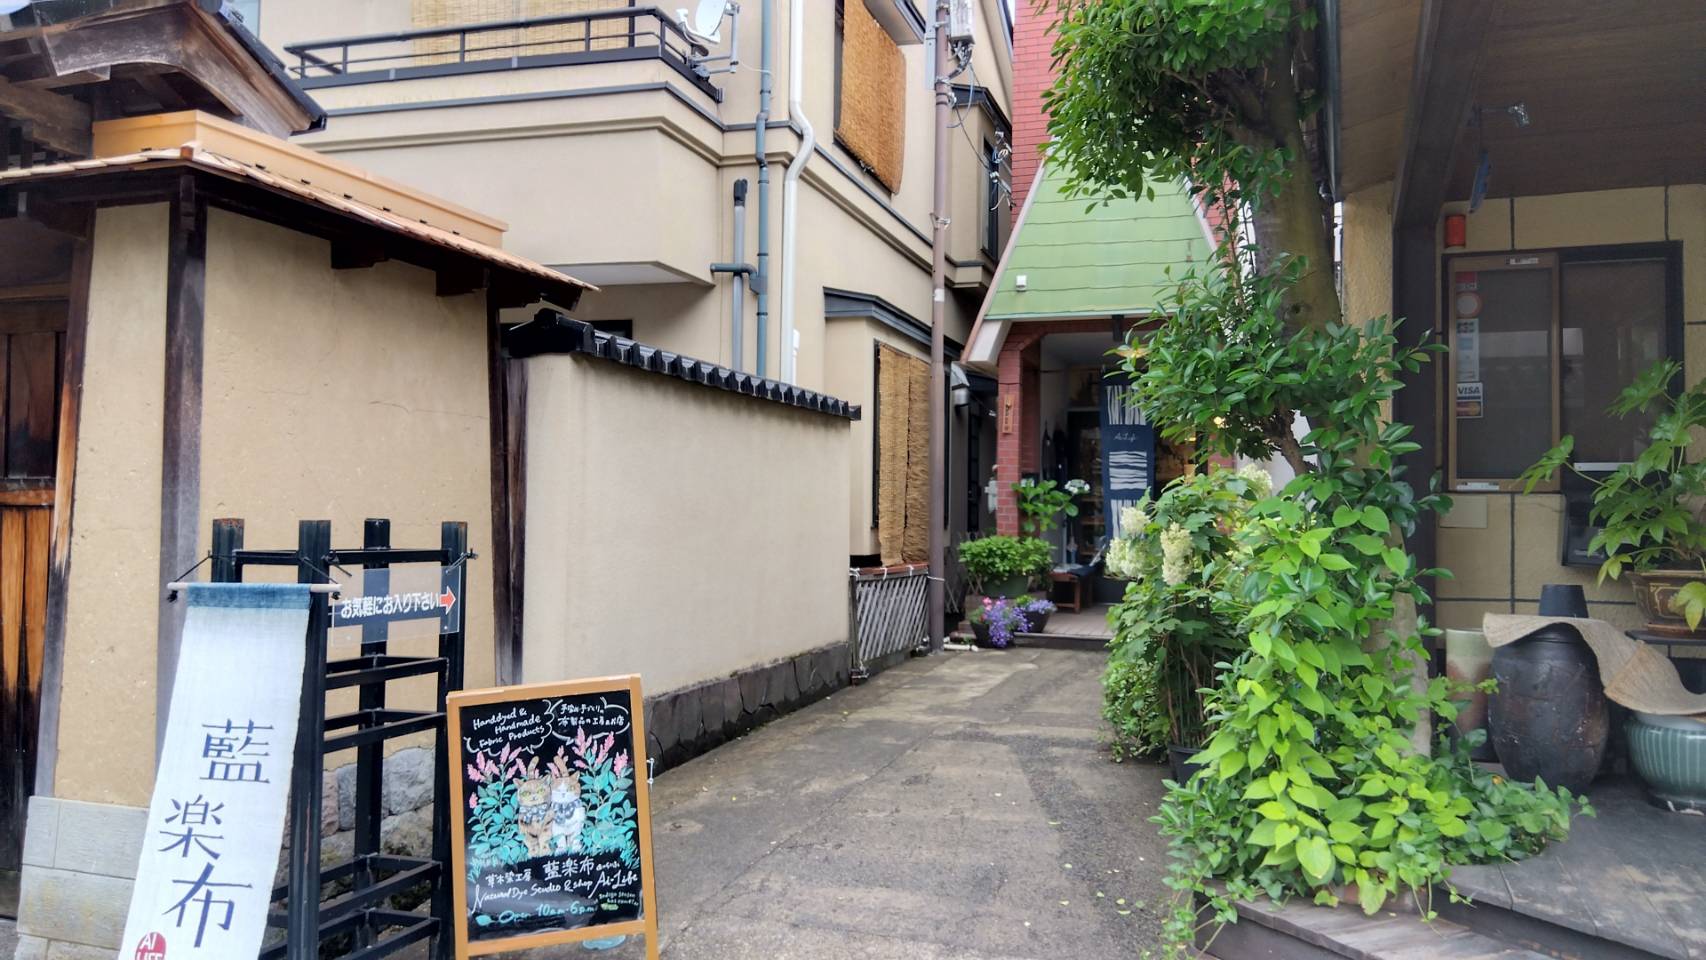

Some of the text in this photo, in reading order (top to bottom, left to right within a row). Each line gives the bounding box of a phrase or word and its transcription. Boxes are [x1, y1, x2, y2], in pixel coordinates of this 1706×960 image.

[1458, 386, 1481, 395] VISA
[341, 592, 440, 619] お気軽にお入り下さい
[519, 707, 527, 716] &
[495, 714, 541, 734] Handmade
[479, 725, 545, 748] Fabric Products
[157, 718, 274, 948] 藍楽布
[542, 856, 594, 881] 藍楽布
[471, 884, 512, 914] Natural
[512, 887, 528, 900] Dye
[530, 882, 561, 896] Studio
[499, 910, 531, 924] Open
[139, 931, 157, 950] AI
